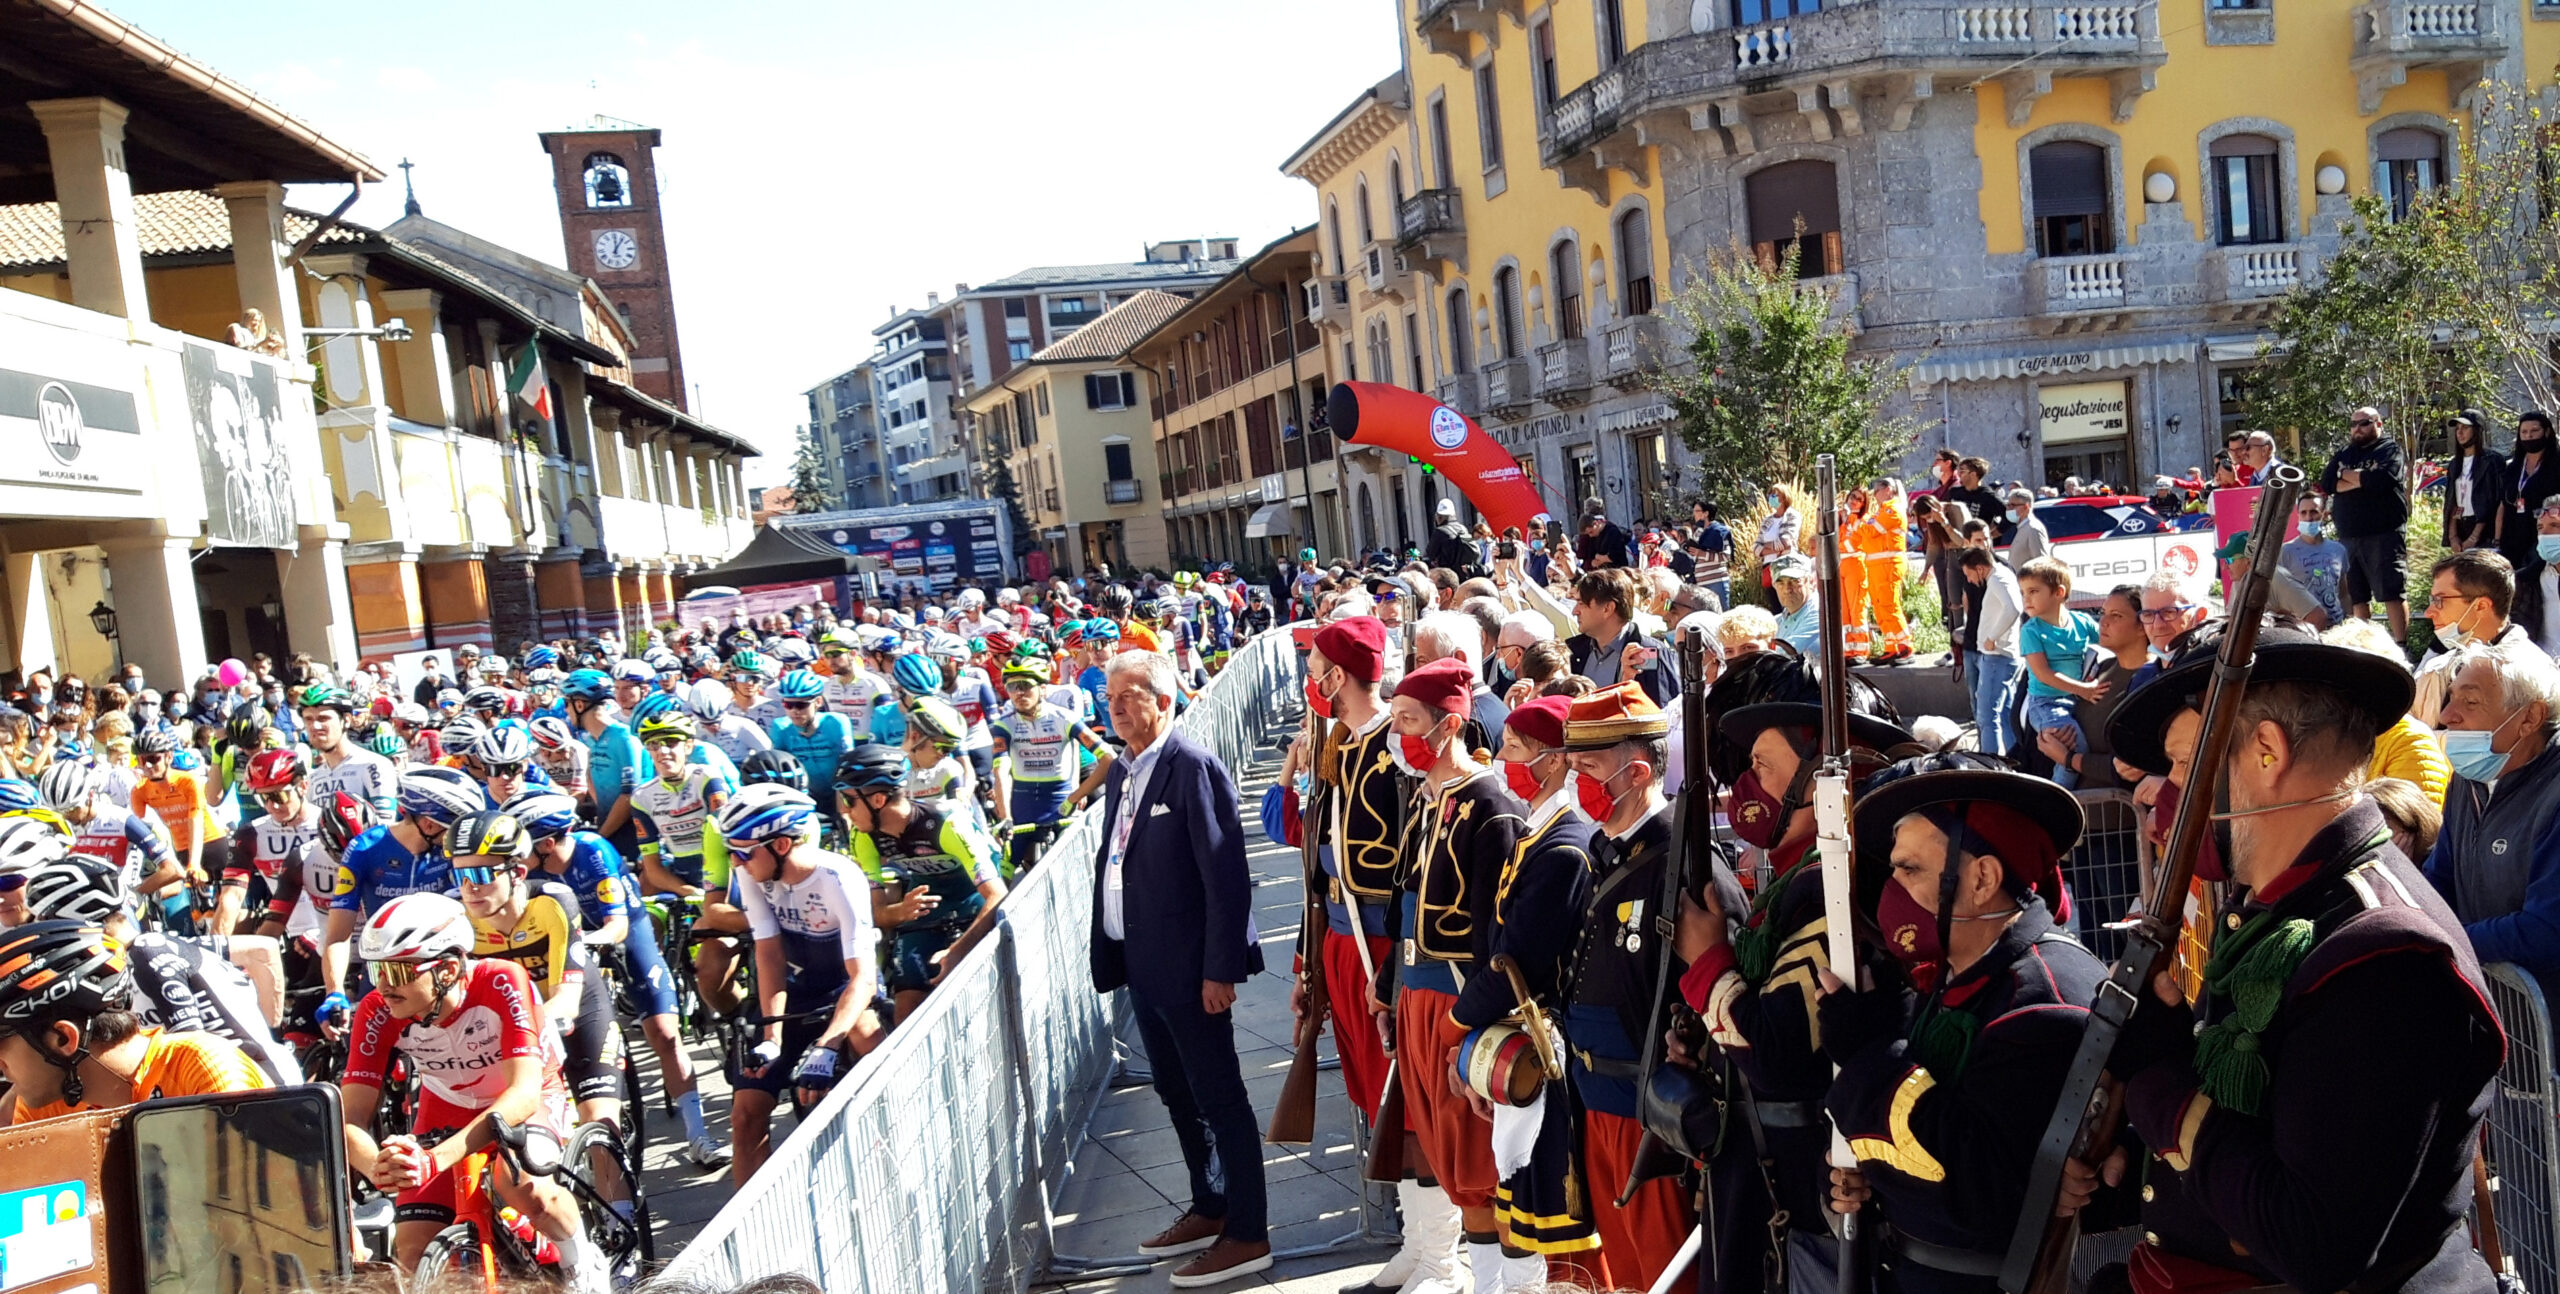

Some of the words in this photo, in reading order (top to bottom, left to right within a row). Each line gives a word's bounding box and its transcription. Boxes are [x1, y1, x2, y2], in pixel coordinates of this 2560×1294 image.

[2050, 352, 2091, 367] MAINO
[315, 779, 346, 796] CAJA
[420, 1049, 502, 1071] ofidis
